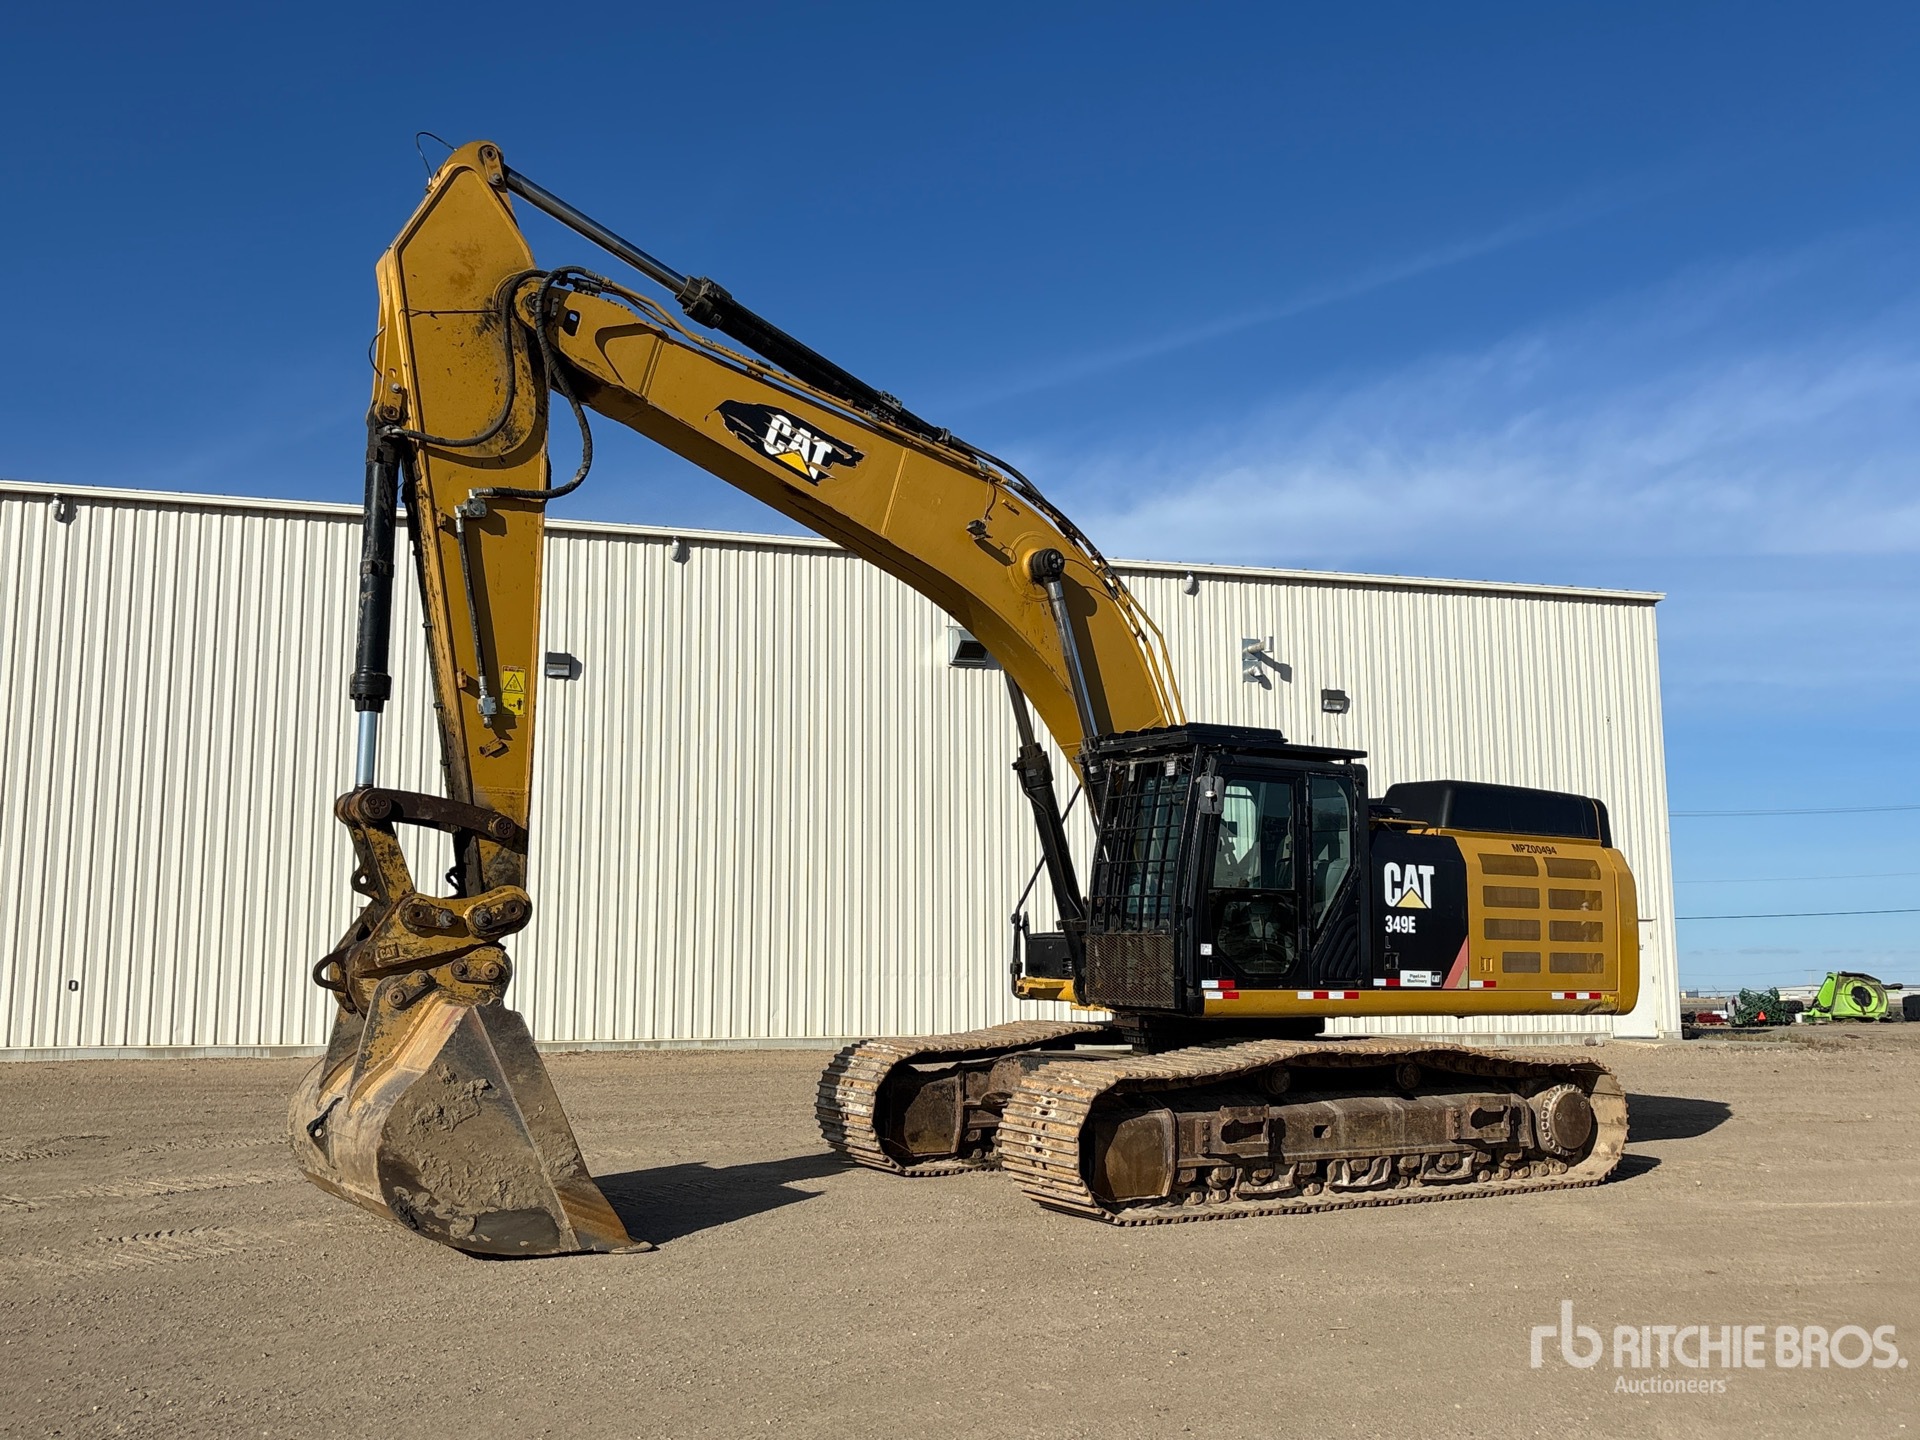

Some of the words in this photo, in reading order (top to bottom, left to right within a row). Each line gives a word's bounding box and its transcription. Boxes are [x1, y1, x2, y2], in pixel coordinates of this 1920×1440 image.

[764, 414, 833, 480] CAT
[1511, 843, 1557, 855] MPZ00494
[1384, 862, 1435, 909] CAT
[1385, 915, 1416, 933] 349E
